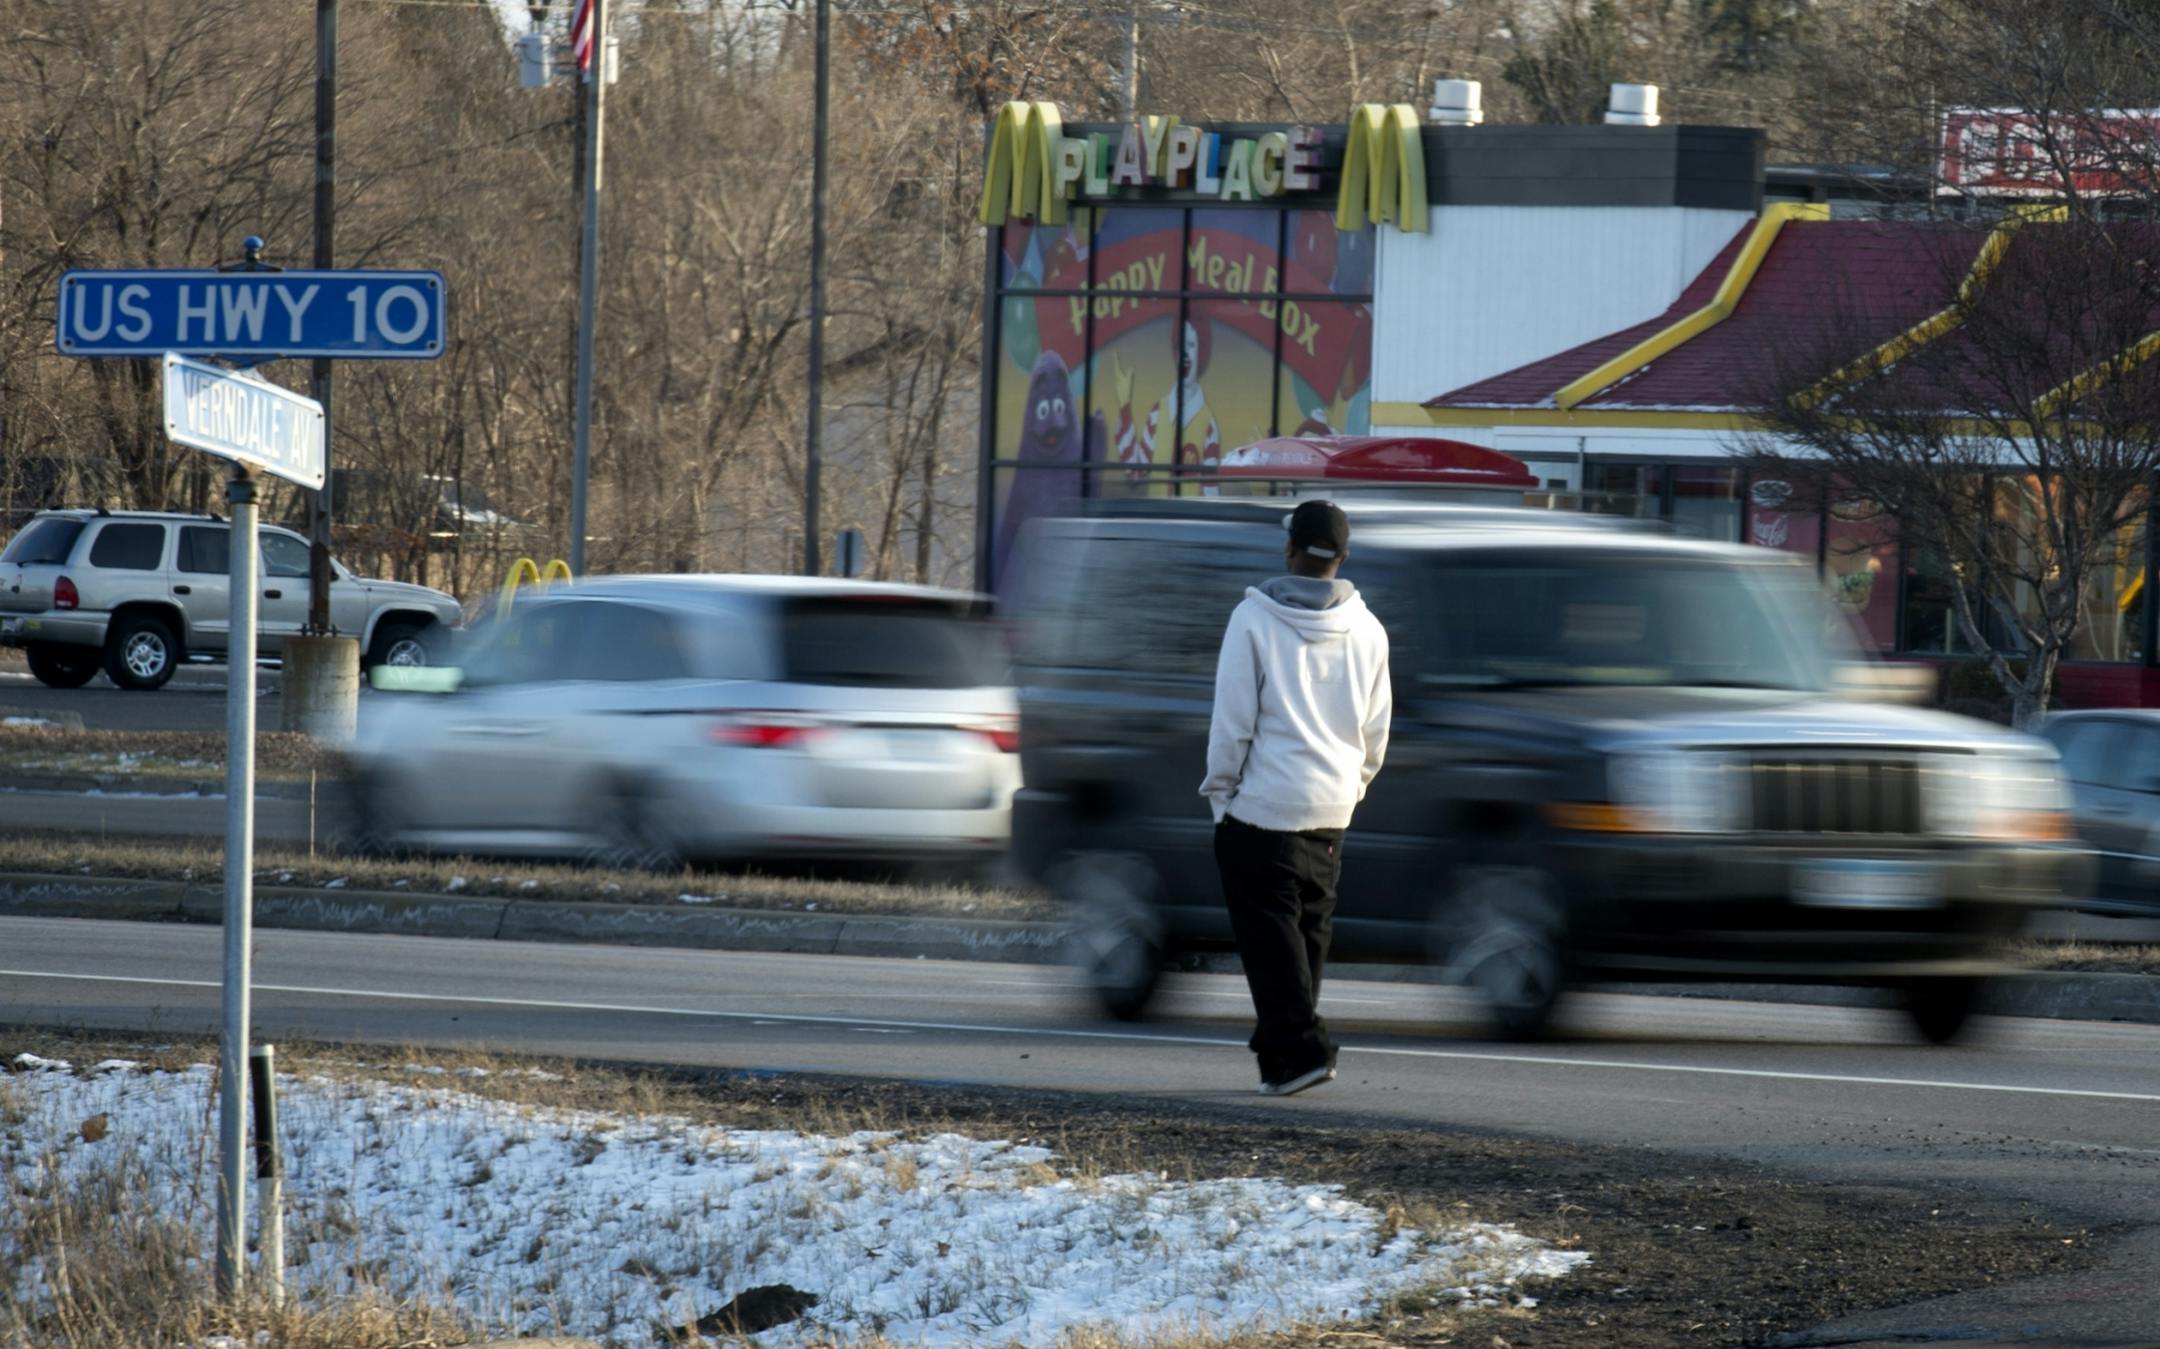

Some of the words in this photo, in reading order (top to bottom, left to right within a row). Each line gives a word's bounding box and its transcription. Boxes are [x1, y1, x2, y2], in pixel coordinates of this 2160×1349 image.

[1054, 114, 1322, 200] PLAYPLACE
[73, 284, 153, 342] US
[176, 284, 321, 343] HWY
[346, 285, 430, 345] 10
[1070, 252, 1166, 336] Happy
[1187, 236, 1255, 304] Meal
[182, 366, 282, 460] VERNDALE
[289, 408, 311, 469] AV
